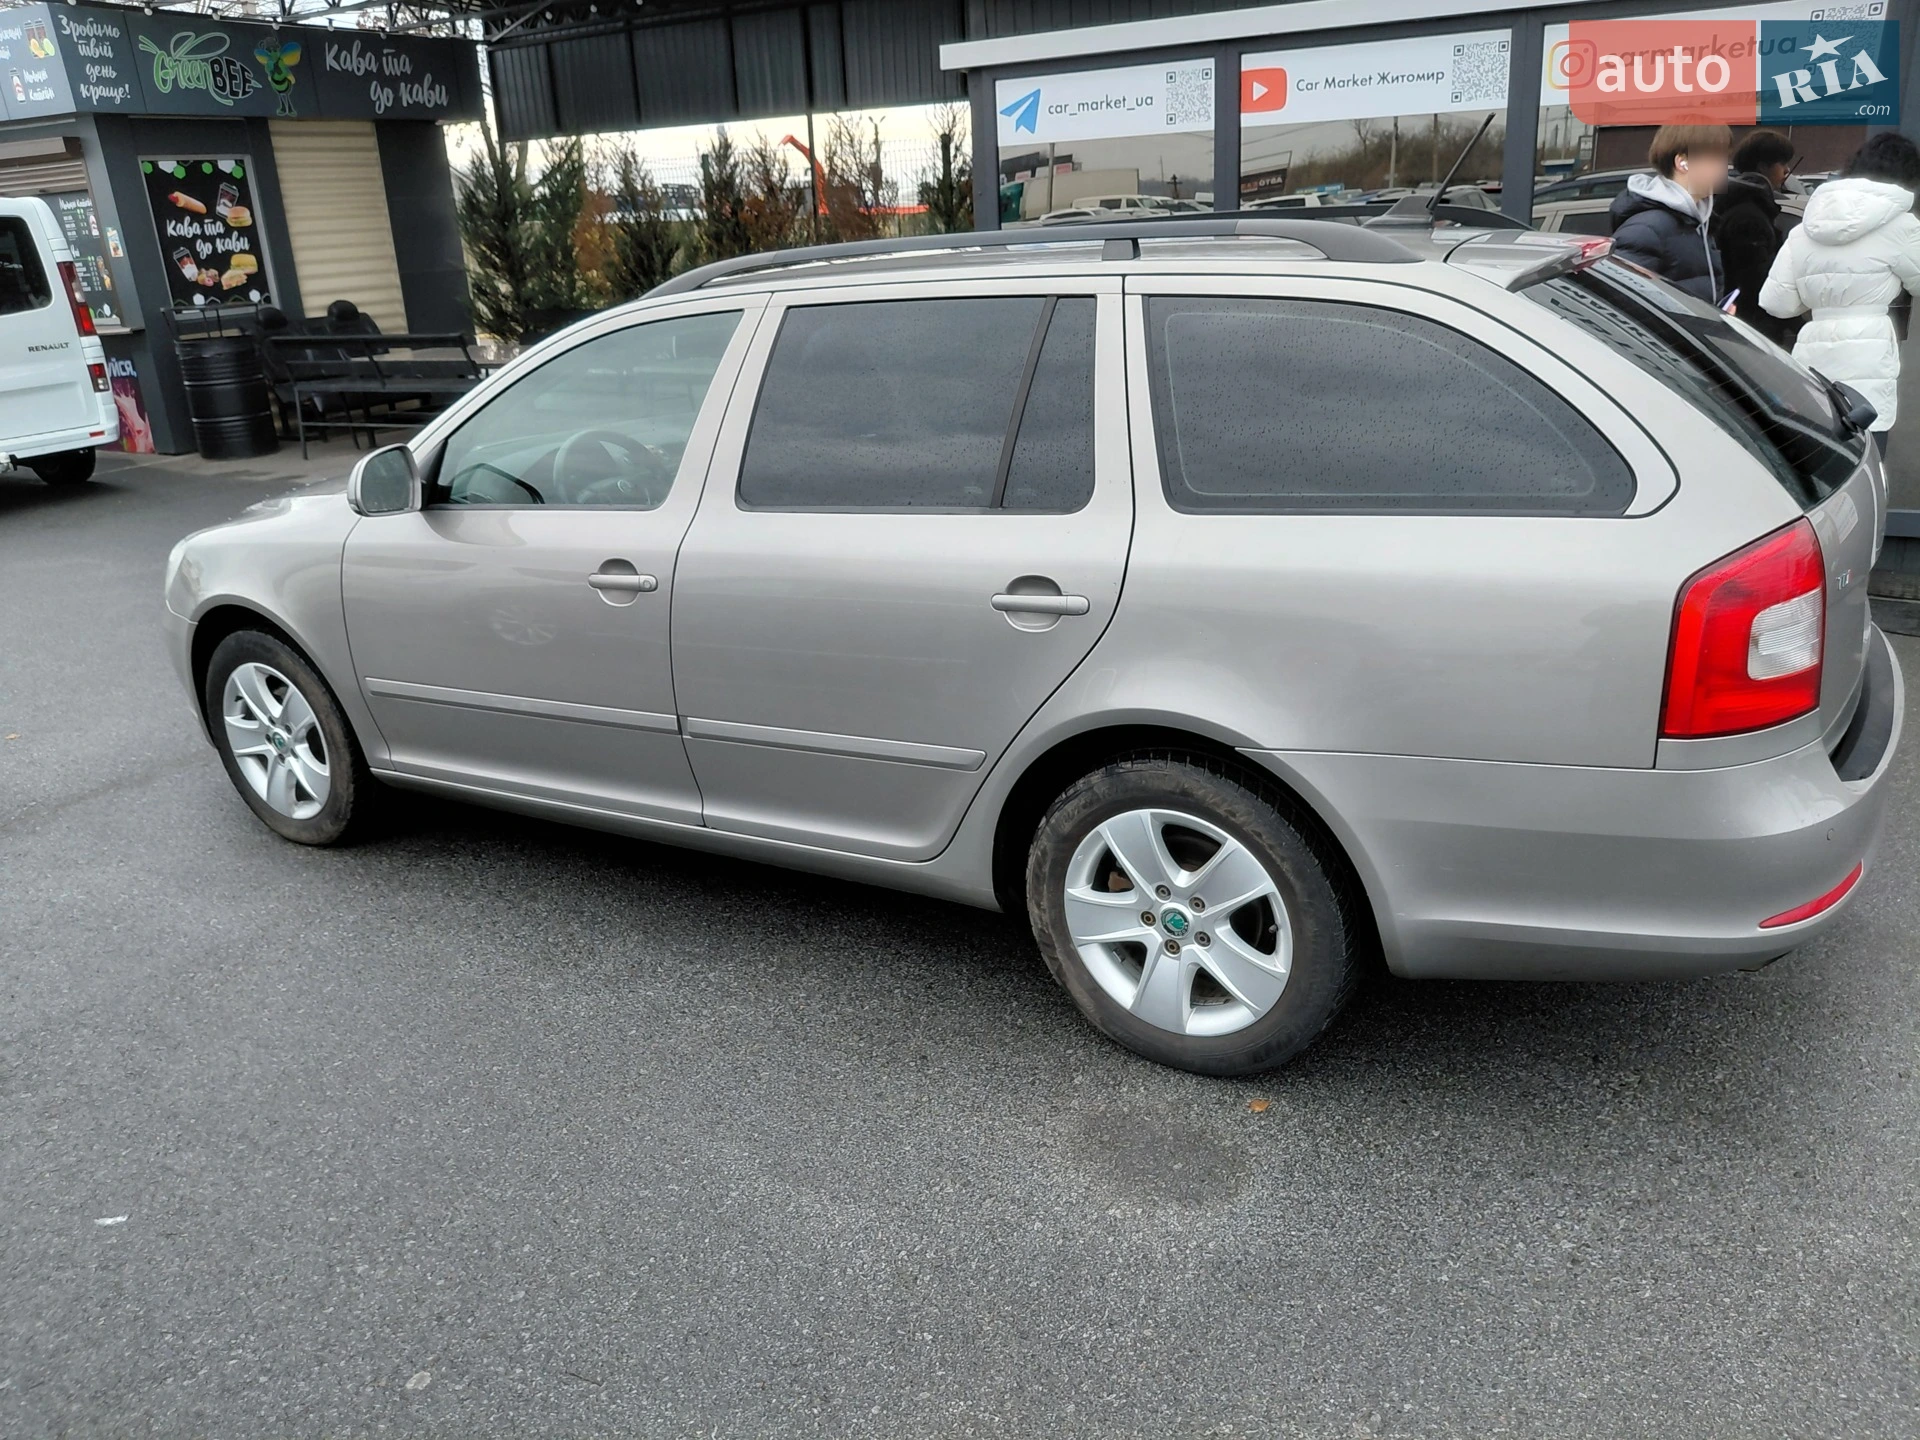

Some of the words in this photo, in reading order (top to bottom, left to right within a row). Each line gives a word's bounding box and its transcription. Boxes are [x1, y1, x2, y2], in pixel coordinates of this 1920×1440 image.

[58, 15, 120, 42] Зробимо
[78, 38, 114, 58] твій
[325, 40, 379, 76] Кава
[382, 49, 413, 76] та
[86, 63, 117, 83] день
[1296, 79, 1320, 92] Car
[1323, 73, 1373, 90] Market
[1377, 71, 1445, 85] Житомир
[80, 84, 131, 105] краще!
[370, 81, 394, 114] до
[399, 73, 449, 108] кави
[1048, 94, 1154, 116] car_market_ua
[166, 216, 202, 238] Кава
[204, 219, 225, 236] та
[196, 239, 213, 260] до
[216, 231, 250, 254] кави
[28, 342, 69, 352] RENAULT
